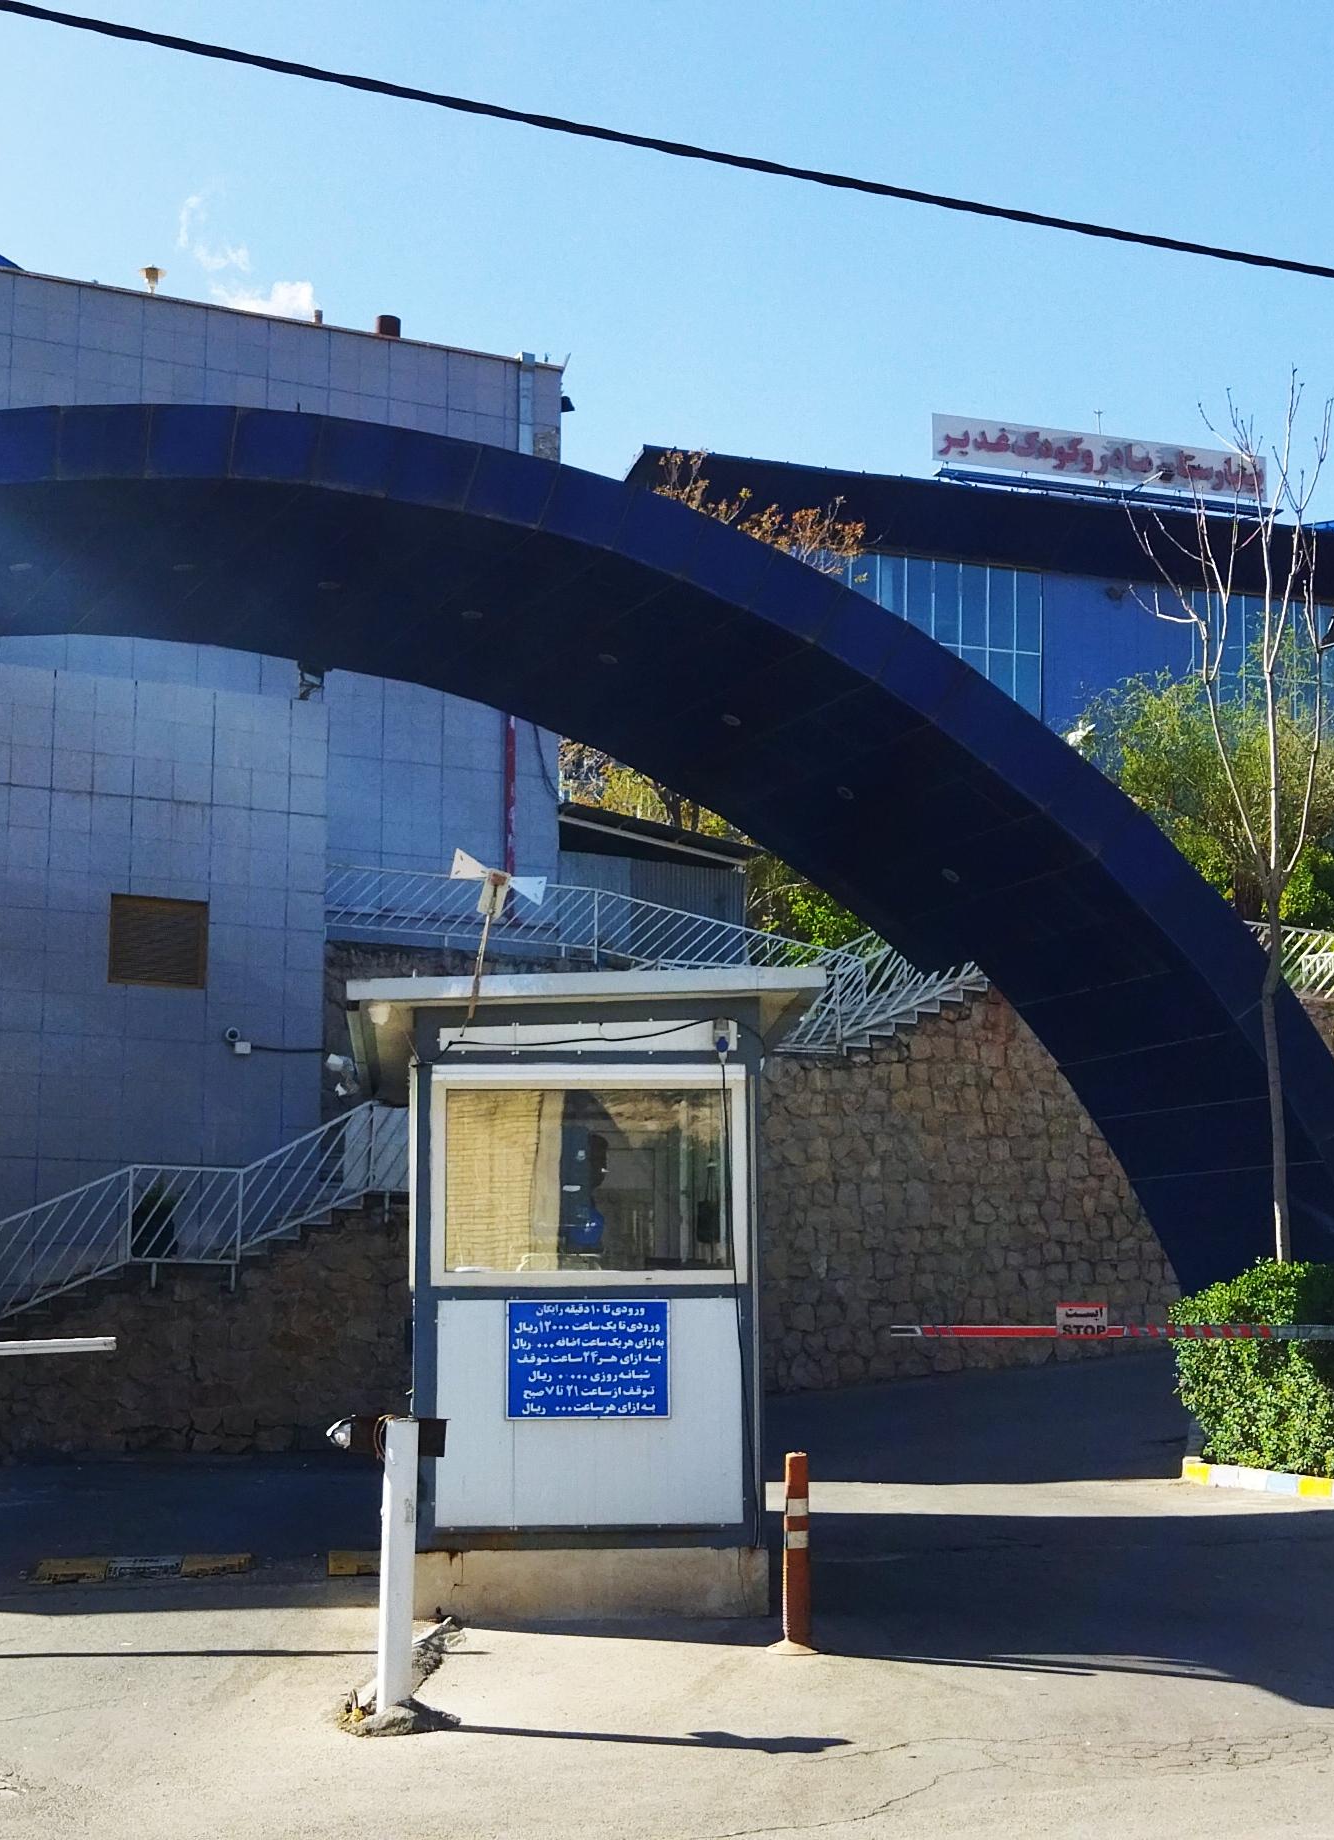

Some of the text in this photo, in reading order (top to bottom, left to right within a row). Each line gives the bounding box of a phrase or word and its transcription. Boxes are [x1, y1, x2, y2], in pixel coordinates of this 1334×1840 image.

[937, 427, 1011, 457] غدیر
[565, 1305, 590, 1316] دقیقه
[592, 1304, 600, 1314] ۱۰
[602, 1304, 611, 1314] تا
[612, 1305, 645, 1316] ورودی
[1065, 1306, 1104, 1322] ایست
[514, 1321, 538, 1334] ریال
[572, 1321, 601, 1331] ساعت
[601, 1321, 616, 1332] یک
[618, 1320, 626, 1330] تا
[626, 1321, 660, 1333] ورودی
[1062, 1324, 1107, 1336] STOP
[512, 1337, 531, 1350] ریال
[555, 1337, 580, 1347] اضافه
[581, 1338, 608, 1347] ساعت
[607, 1338, 622, 1348] یک
[623, 1339, 634, 1349] هر
[635, 1337, 655, 1349] ازای
[656, 1339, 665, 1349] به
[517, 1351, 662, 1366] به ازای هر ۲۴ ساعت توقف
[528, 1370, 553, 1382] ریال
[590, 1372, 618, 1383] روزی
[619, 1369, 651, 1380] شبانه
[523, 1385, 656, 1400] توقف از ساعت ۲۱ تا ۷ صبح
[521, 1402, 546, 1415] ریال
[573, 1402, 607, 1412] ساعت
[607, 1404, 617, 1414] هر
[618, 1402, 640, 1413] ازای
[641, 1403, 656, 1413] به
